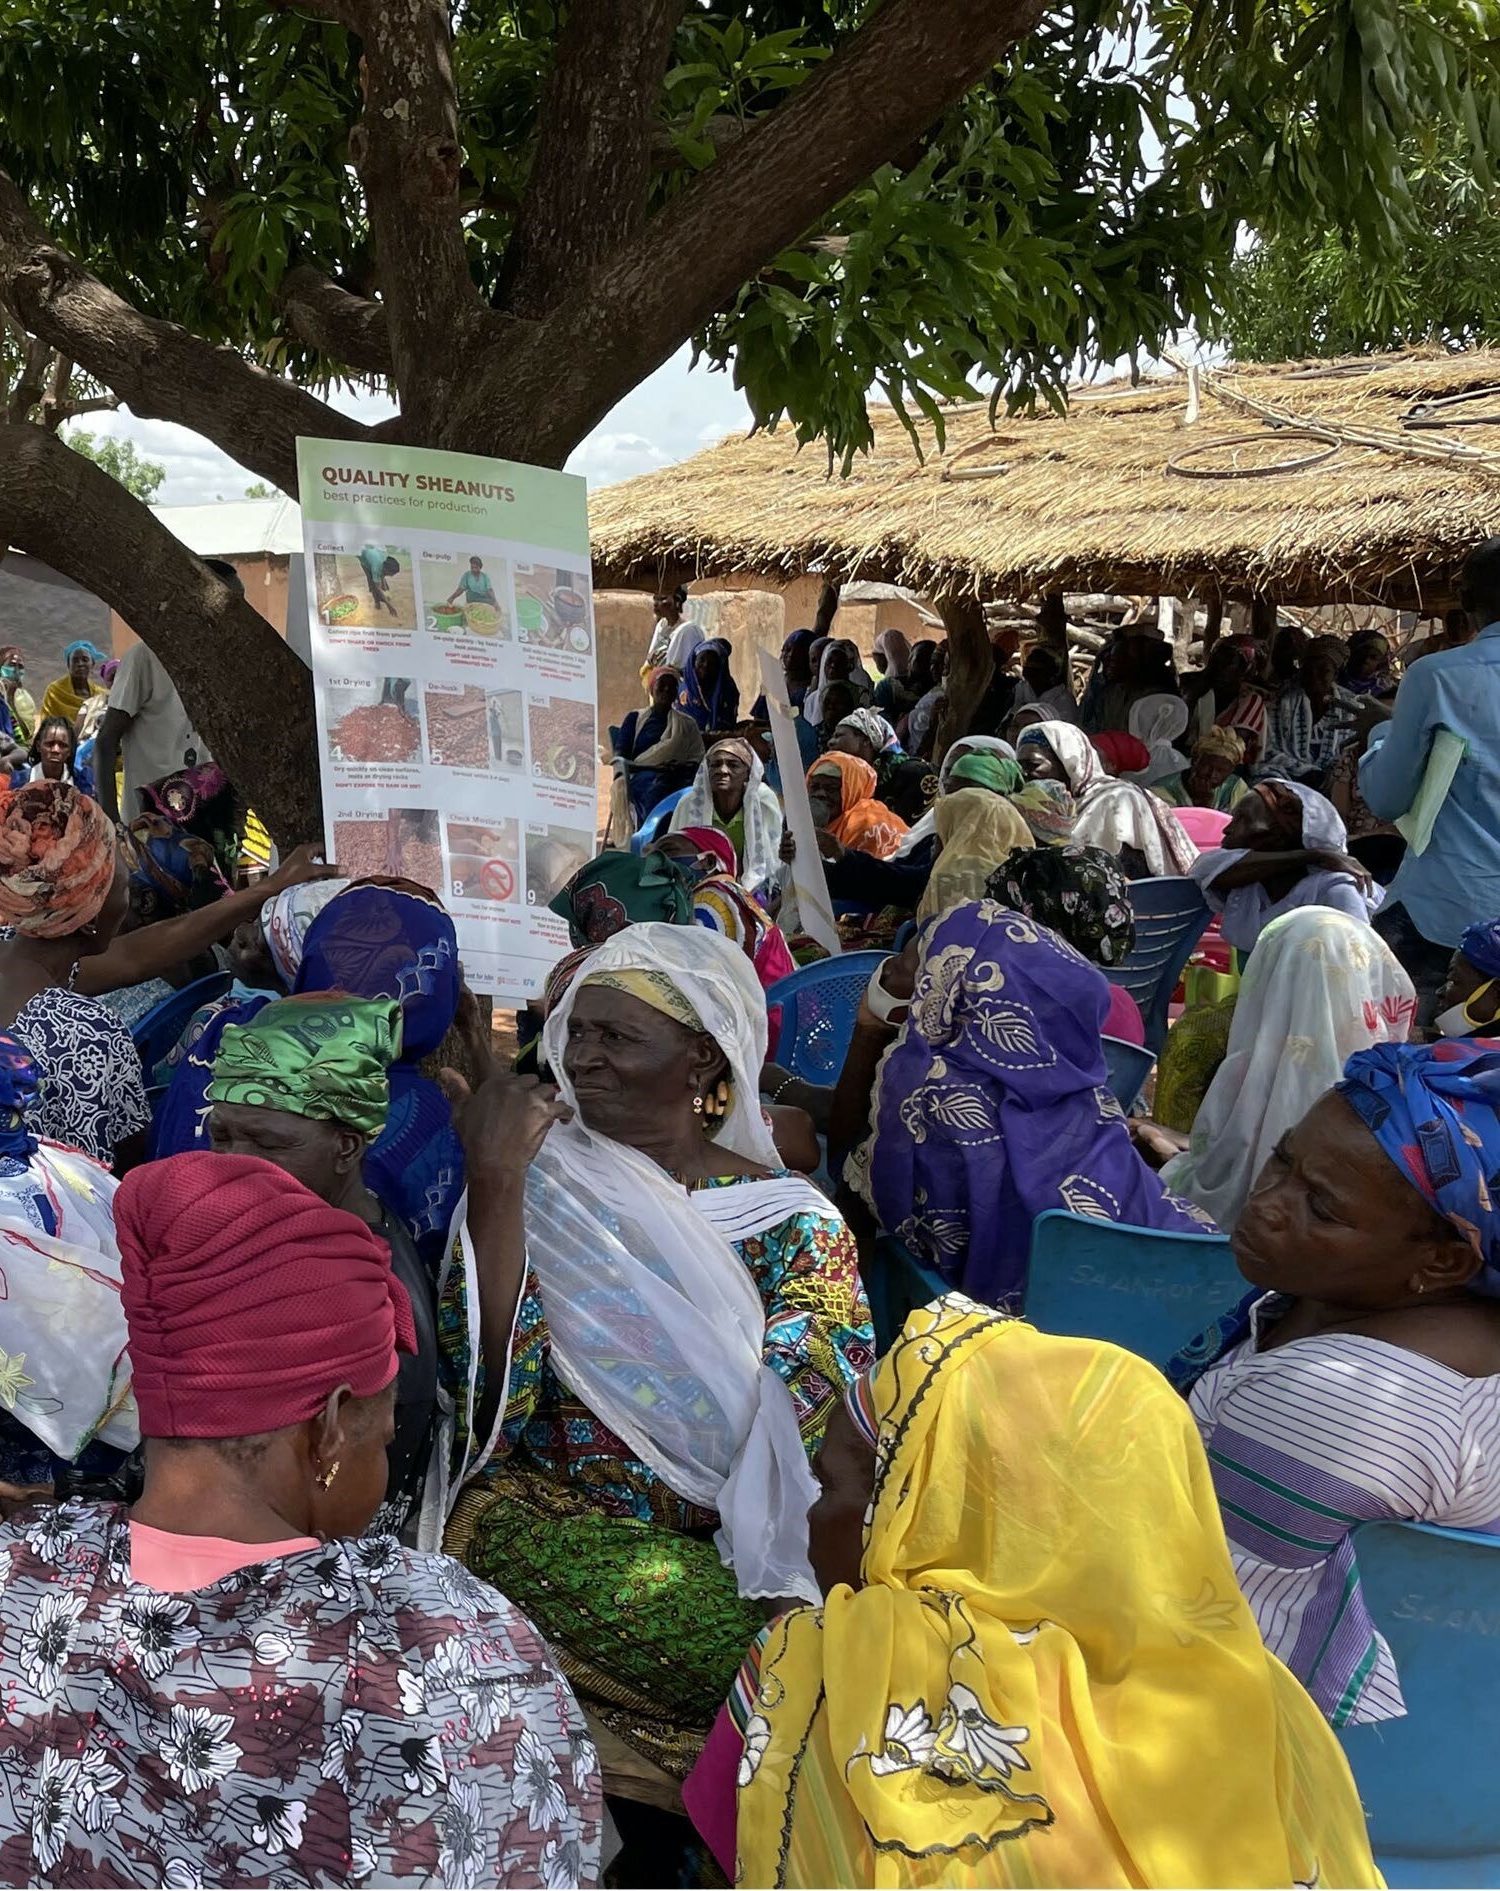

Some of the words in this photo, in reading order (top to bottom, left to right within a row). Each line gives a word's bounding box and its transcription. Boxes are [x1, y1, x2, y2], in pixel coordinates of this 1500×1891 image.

[322, 467, 410, 488] QUALITY
[416, 475, 516, 502] SHEANUTS
[323, 490, 348, 502] best
[353, 491, 406, 506] practices
[408, 497, 424, 508] for
[428, 501, 487, 516] production
[317, 544, 344, 552] Collect
[423, 551, 451, 561] De-pulp
[322, 610, 330, 624] 1
[427, 616, 438, 631] 2
[518, 627, 529, 642] 3
[344, 679, 370, 687] Drying
[330, 745, 344, 760] 4
[432, 749, 443, 763] 5
[533, 762, 542, 777] 6
[356, 810, 383, 819] Drying
[453, 880, 464, 896] 8
[528, 890, 536, 905] 9
